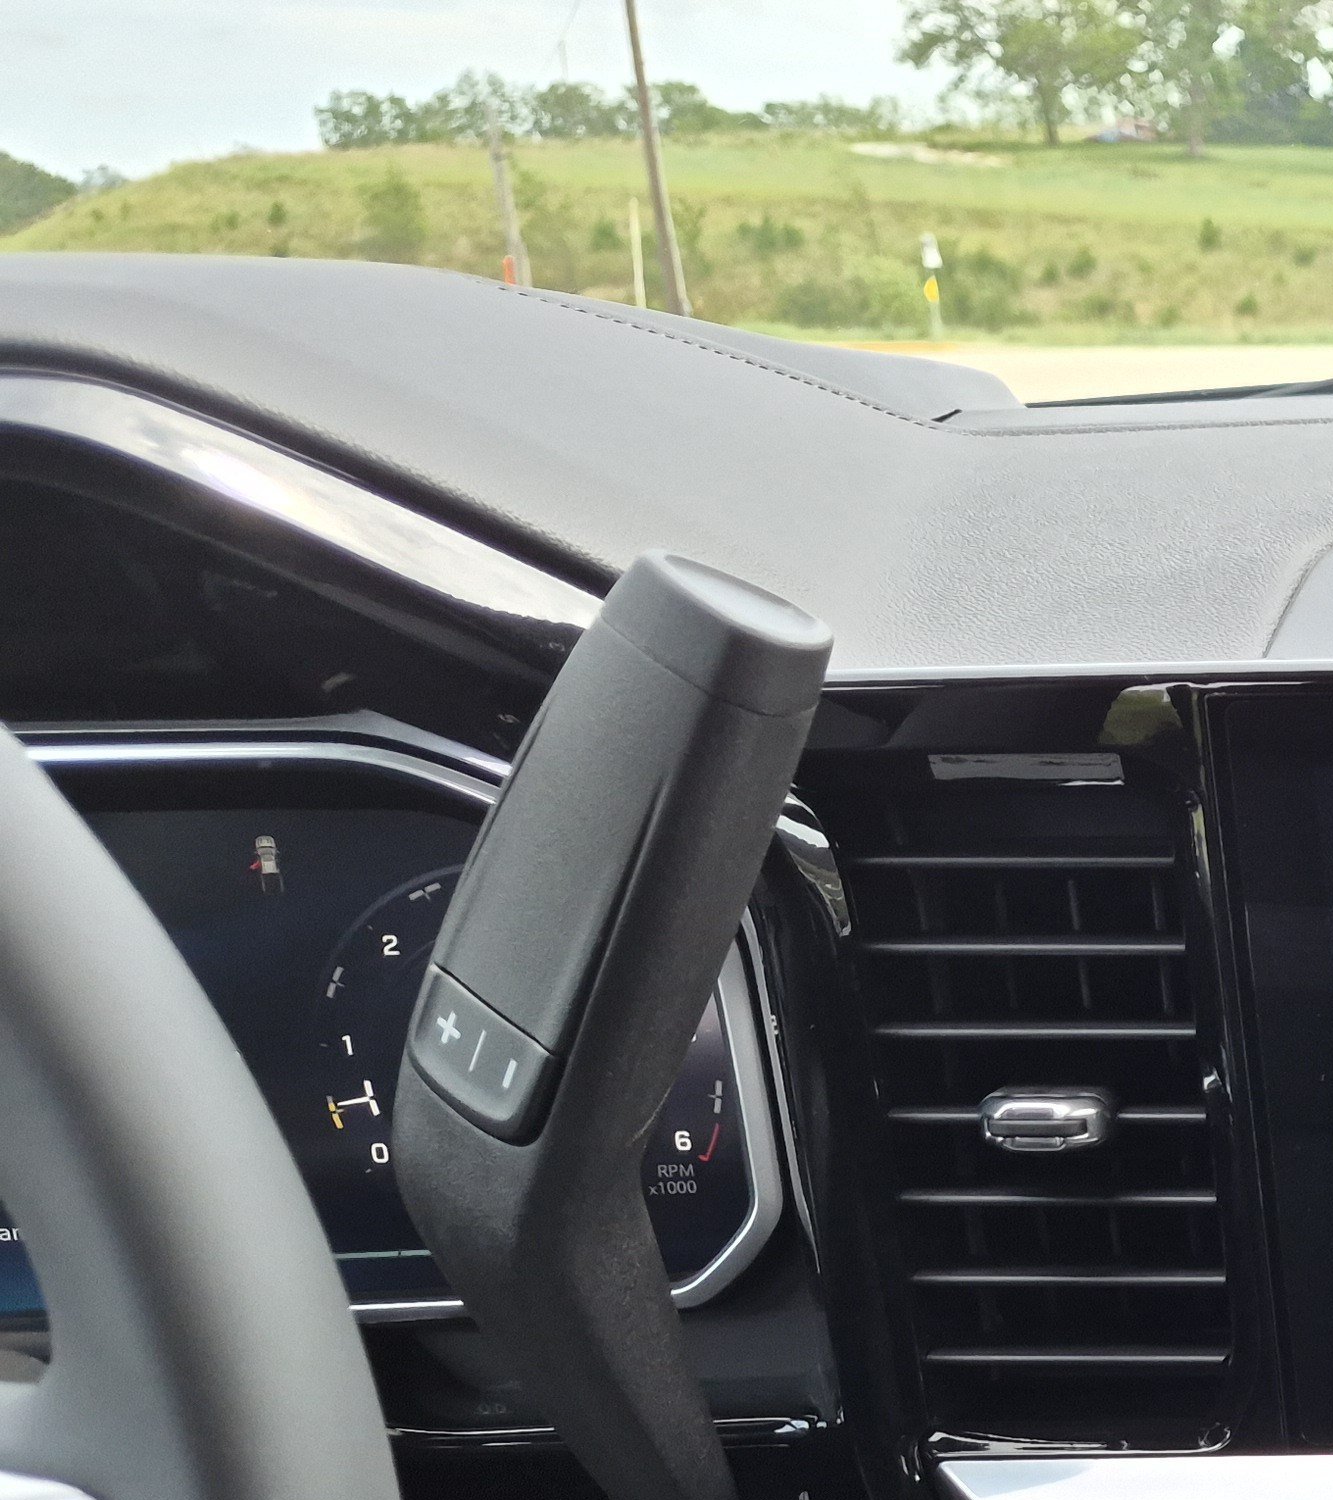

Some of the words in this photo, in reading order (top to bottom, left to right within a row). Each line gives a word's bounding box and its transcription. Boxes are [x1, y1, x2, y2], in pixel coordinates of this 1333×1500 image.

[382, 934, 401, 956] 2
[341, 1034, 354, 1056] 1
[674, 1130, 692, 1151] 6
[370, 1142, 390, 1164] 0
[657, 1164, 695, 1178] RPM
[649, 1181, 697, 1196] x1000
